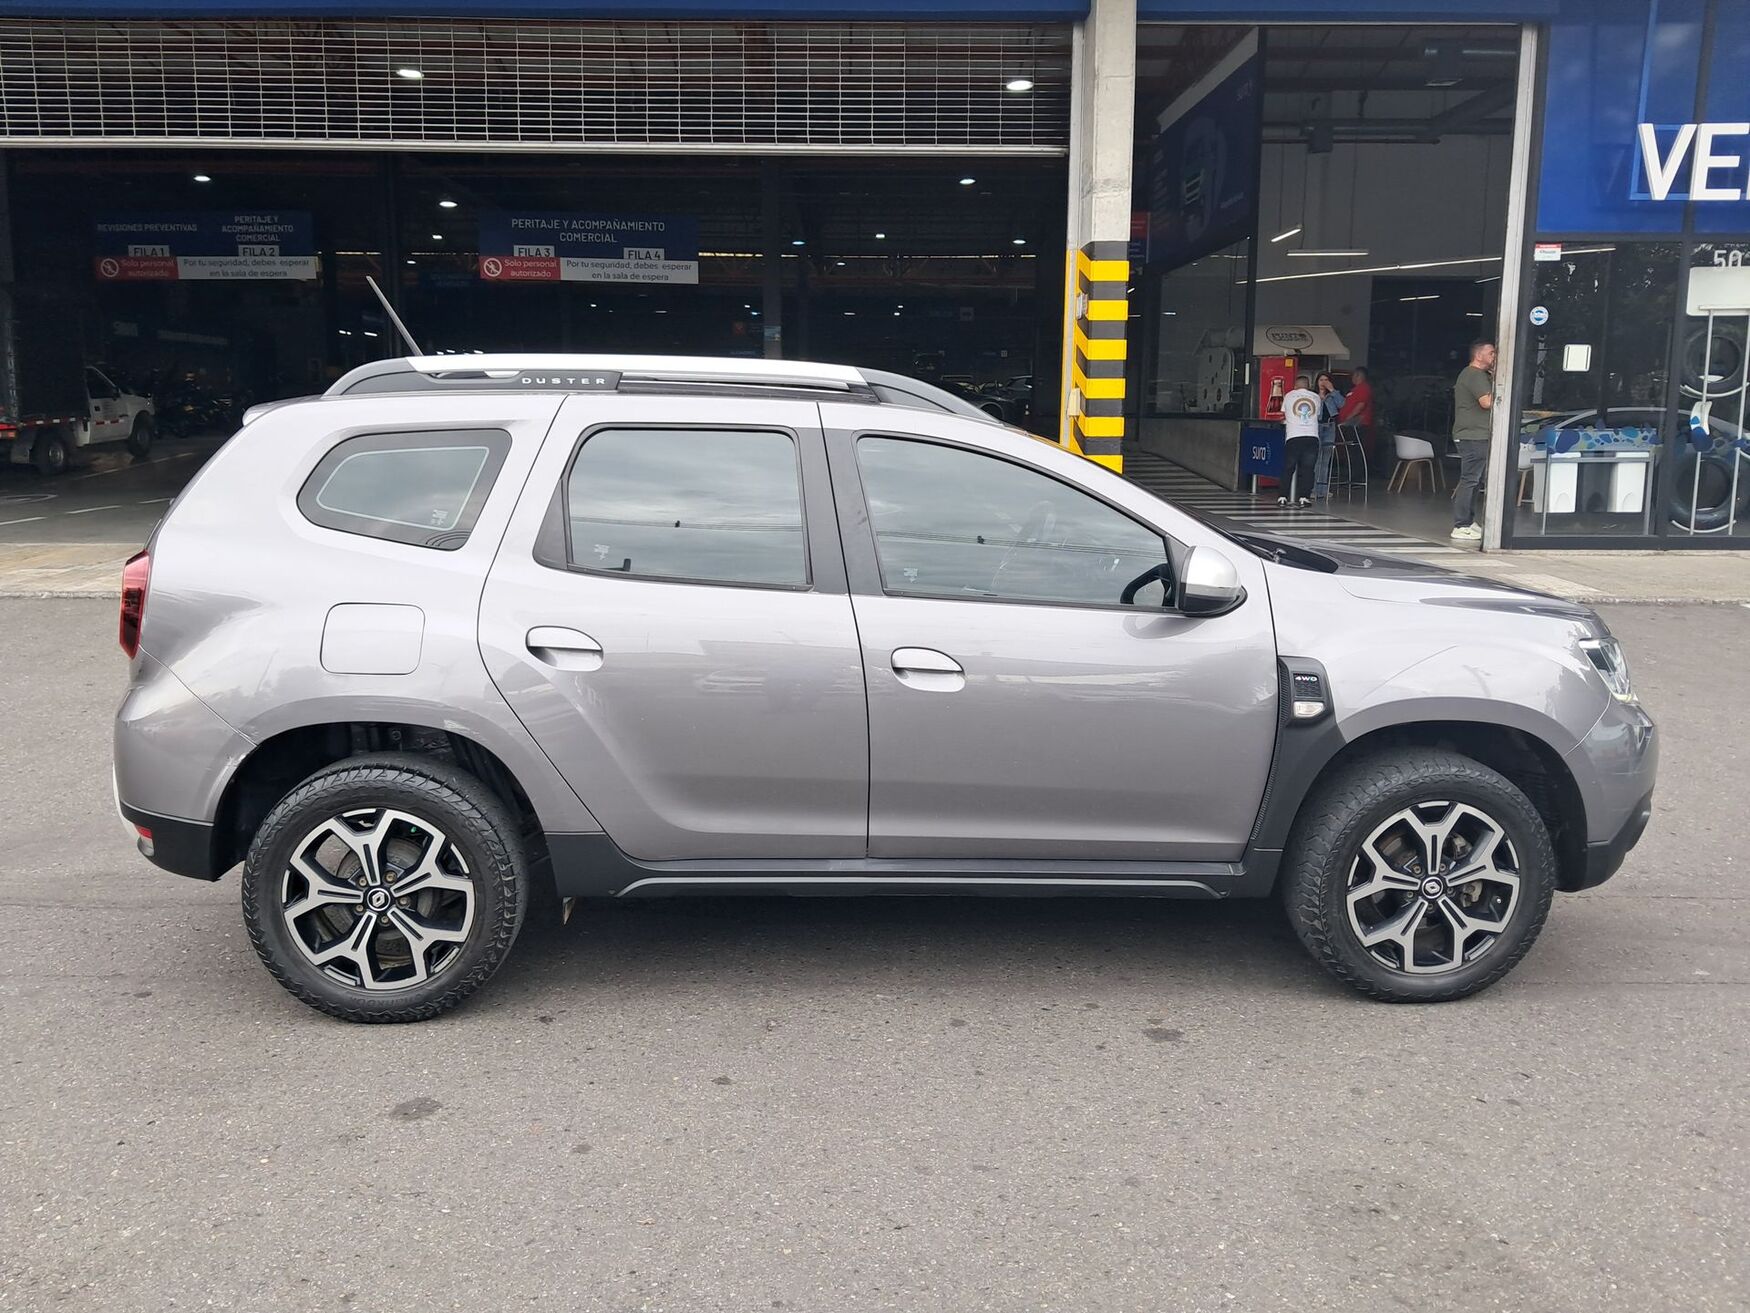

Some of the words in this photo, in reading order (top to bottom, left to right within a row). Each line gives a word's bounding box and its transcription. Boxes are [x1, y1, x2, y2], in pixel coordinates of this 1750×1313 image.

[1638, 123, 1750, 200] VE
[234, 215, 272, 223] PERITAJE
[144, 223, 197, 232] PREVENTIVAS
[222, 223, 294, 233] ACOMPAÑAMIENTO
[511, 218, 560, 229] PERITAJE
[562, 219, 569, 229] Y
[571, 218, 665, 232] ACOMPAÑAMIENTO
[236, 233, 281, 242] COMERCIAL
[559, 232, 618, 243] COMERCIAL
[134, 247, 158, 256] FILA
[243, 247, 267, 256] FILA
[269, 247, 275, 256] 2
[518, 247, 541, 257] FILA
[544, 247, 550, 257] 3
[628, 250, 652, 260] FILA
[654, 250, 660, 260] 4
[140, 259, 174, 269] personal
[279, 260, 310, 268] esperar
[504, 259, 522, 267] Solo
[523, 259, 557, 269] personal
[634, 262, 657, 270] debes
[662, 263, 691, 272] esperar
[260, 271, 287, 279] espera
[510, 269, 552, 277] autorizado
[612, 272, 628, 280] sala
[642, 274, 669, 282] espera
[522, 377, 606, 385] DUSTER
